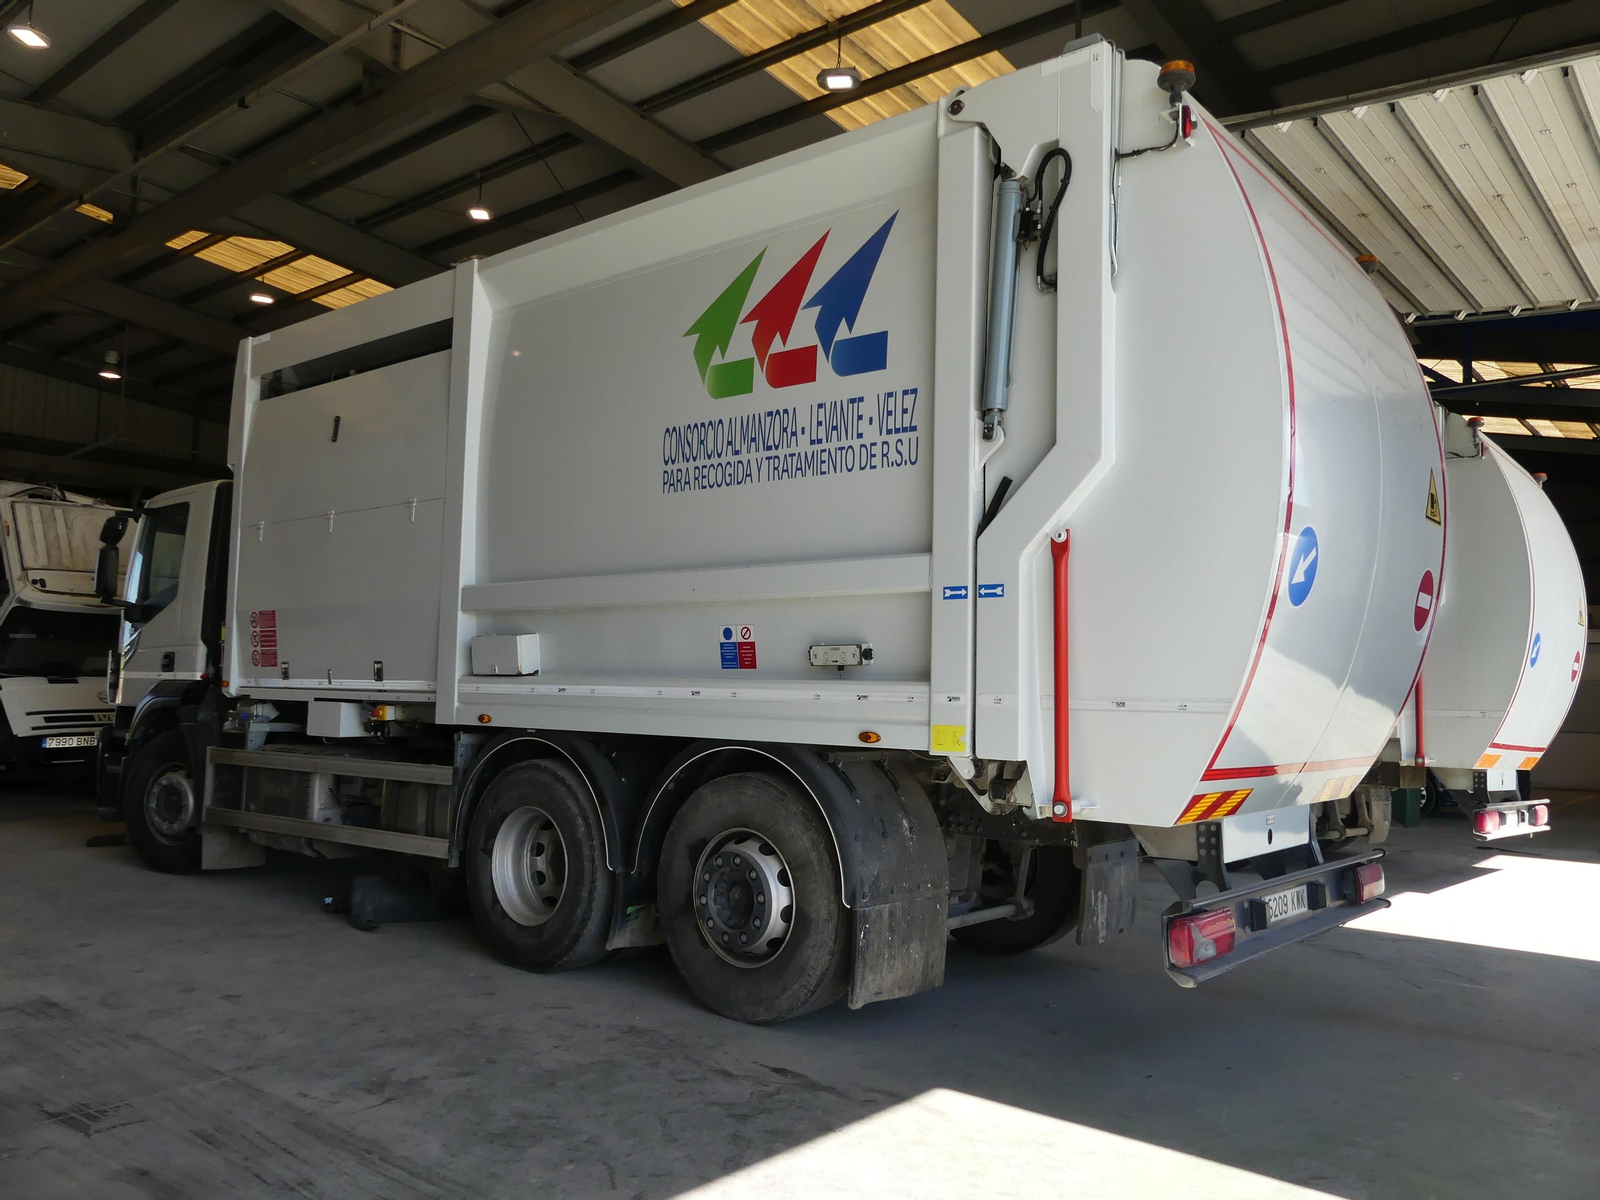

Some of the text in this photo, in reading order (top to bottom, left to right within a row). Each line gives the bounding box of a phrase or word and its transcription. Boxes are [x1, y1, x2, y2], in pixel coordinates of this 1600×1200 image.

[662, 388, 918, 466] CONSORCIO ALMANZORA LEVANTE VELEZ
[662, 436, 919, 494] PARA RECOGIDA Y TRATAMIENTO DE R.S.U
[48, 737, 95, 746] 7990 BNB
